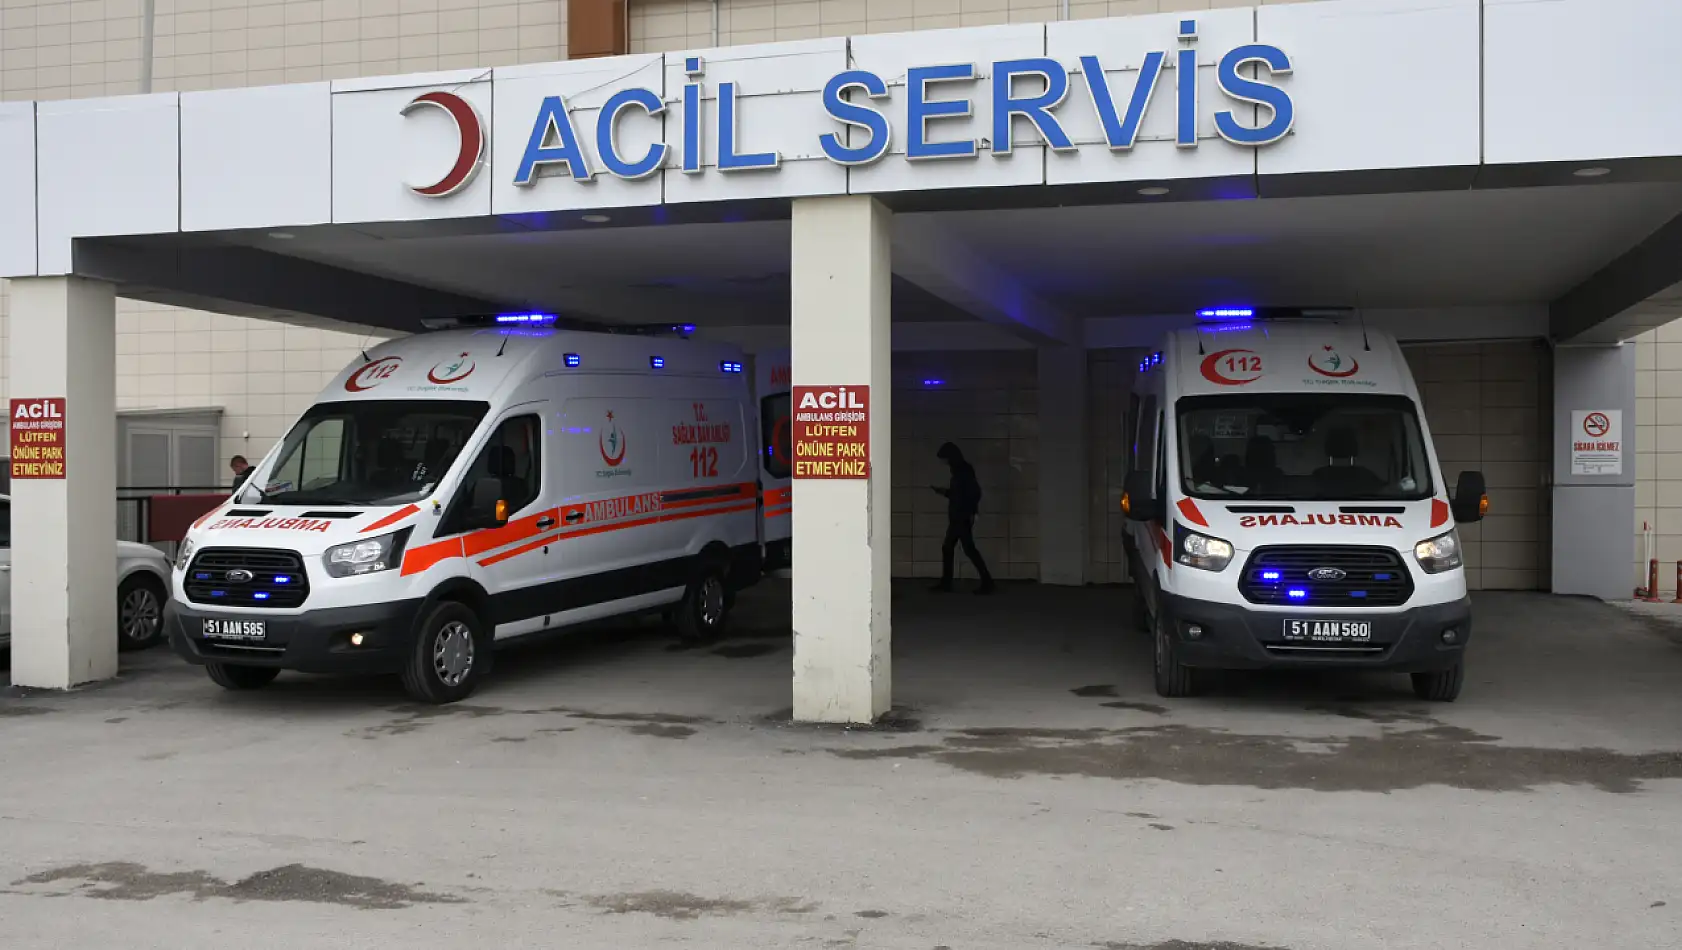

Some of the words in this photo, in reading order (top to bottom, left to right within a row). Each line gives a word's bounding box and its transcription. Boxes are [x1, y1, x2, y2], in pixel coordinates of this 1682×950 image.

[512, 56, 781, 188] ACİL
[817, 18, 1296, 166] SERVİS
[366, 364, 399, 380] 112
[1225, 356, 1263, 373] 112
[799, 387, 864, 409] ACİL
[15, 400, 62, 418] ACİL
[796, 412, 833, 422] AMBULANS
[19, 431, 56, 442] LÜTFEN
[805, 424, 857, 436] LÜTFEN
[13, 445, 40, 459] ÖNÜNE
[42, 446, 62, 459] PARK
[796, 440, 834, 457] ÖNÜNE
[837, 442, 866, 457] PARK
[13, 461, 62, 475] ETMEYİNİZ
[689, 446, 719, 478] 112
[796, 459, 866, 476] ETMEYİNİZ
[584, 494, 660, 522] AMBULANS
[208, 619, 221, 634] 51
[222, 620, 243, 636] AAN
[243, 622, 265, 637] 585
[1291, 621, 1309, 636] 51
[1313, 622, 1340, 637] AAN
[1341, 623, 1369, 638] 580
